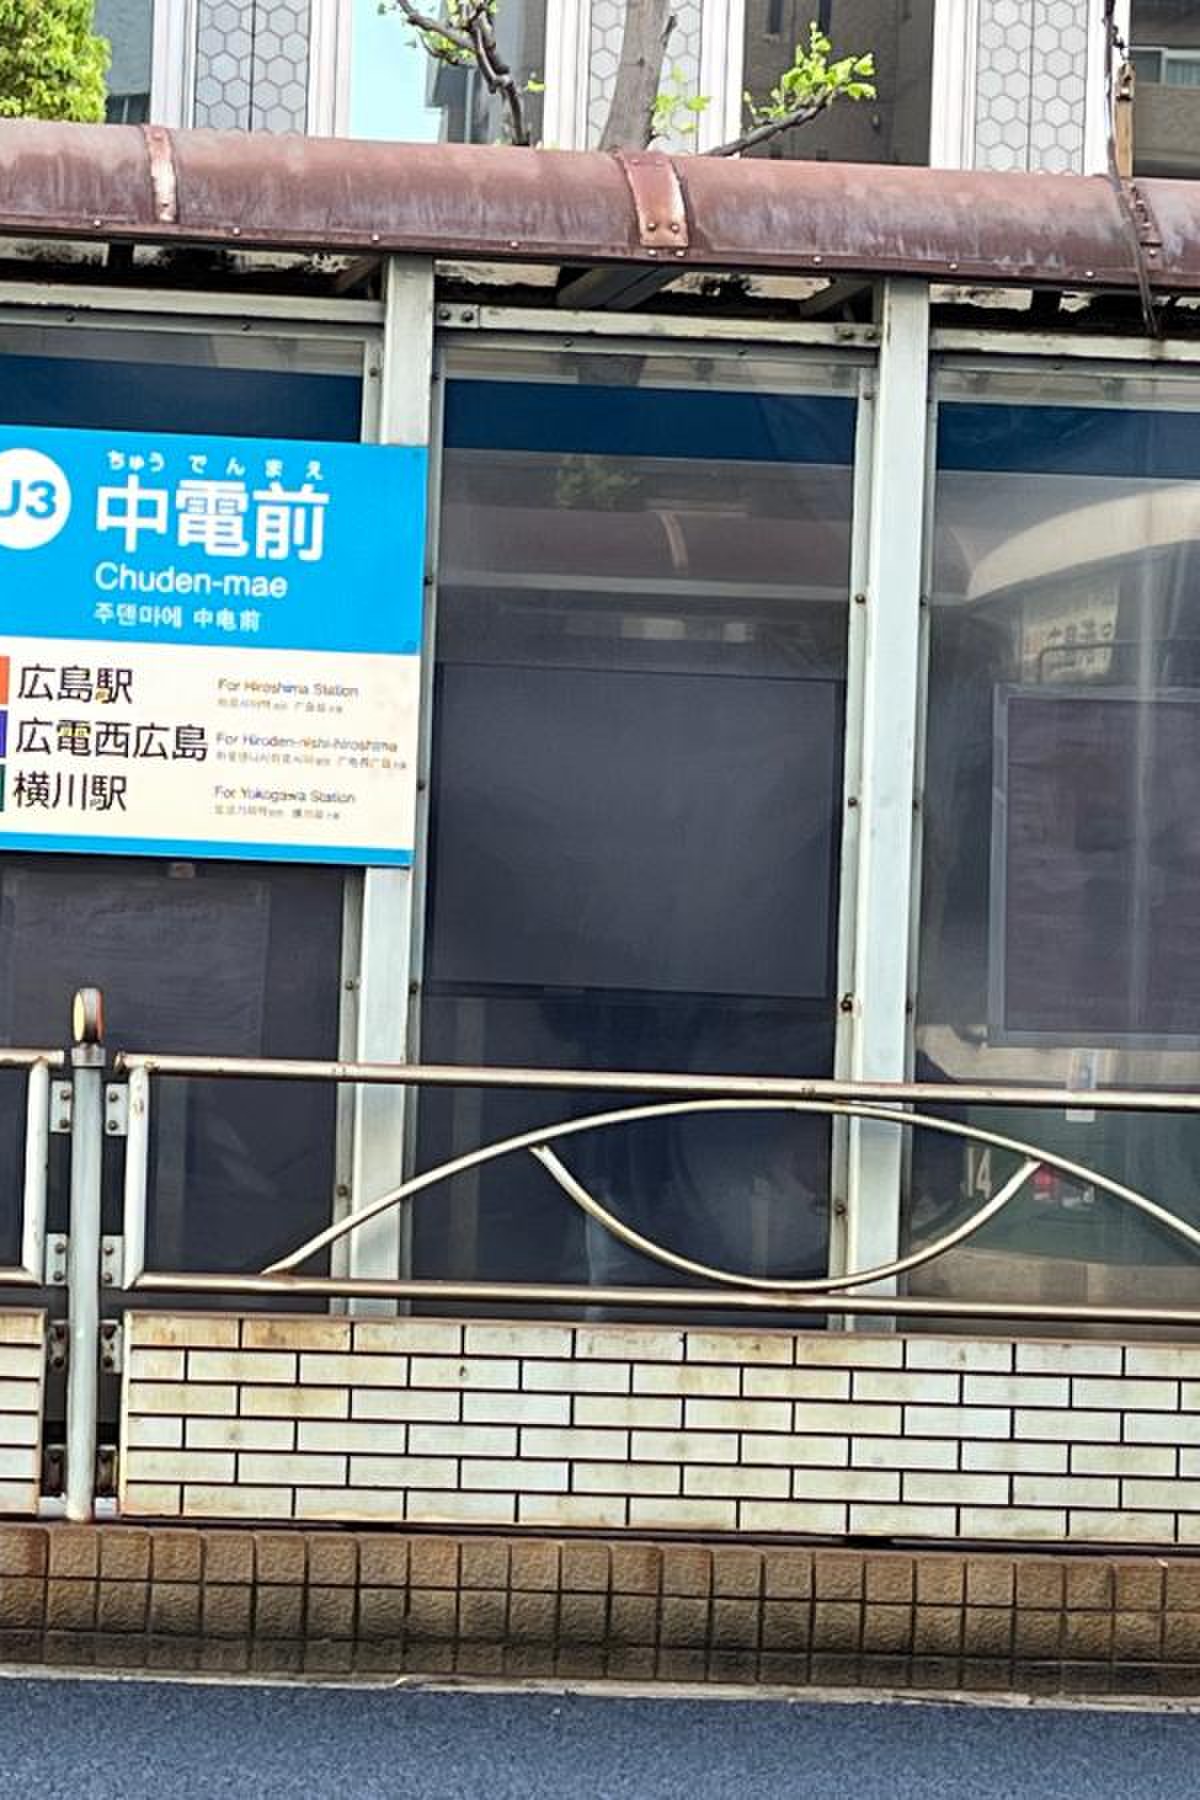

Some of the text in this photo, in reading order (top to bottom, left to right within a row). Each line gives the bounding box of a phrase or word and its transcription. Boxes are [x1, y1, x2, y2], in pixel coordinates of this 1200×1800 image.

[94, 473, 330, 562] 中電前
[94, 562, 288, 598] Chuden-mae
[18, 664, 133, 704] 広島駅
[218, 677, 359, 697] For Hiroshima Station
[15, 717, 208, 762] 広電西広島
[216, 732, 238, 746] For
[13, 770, 127, 811] 横川駅
[214, 785, 356, 804] For Yokogawa Station
